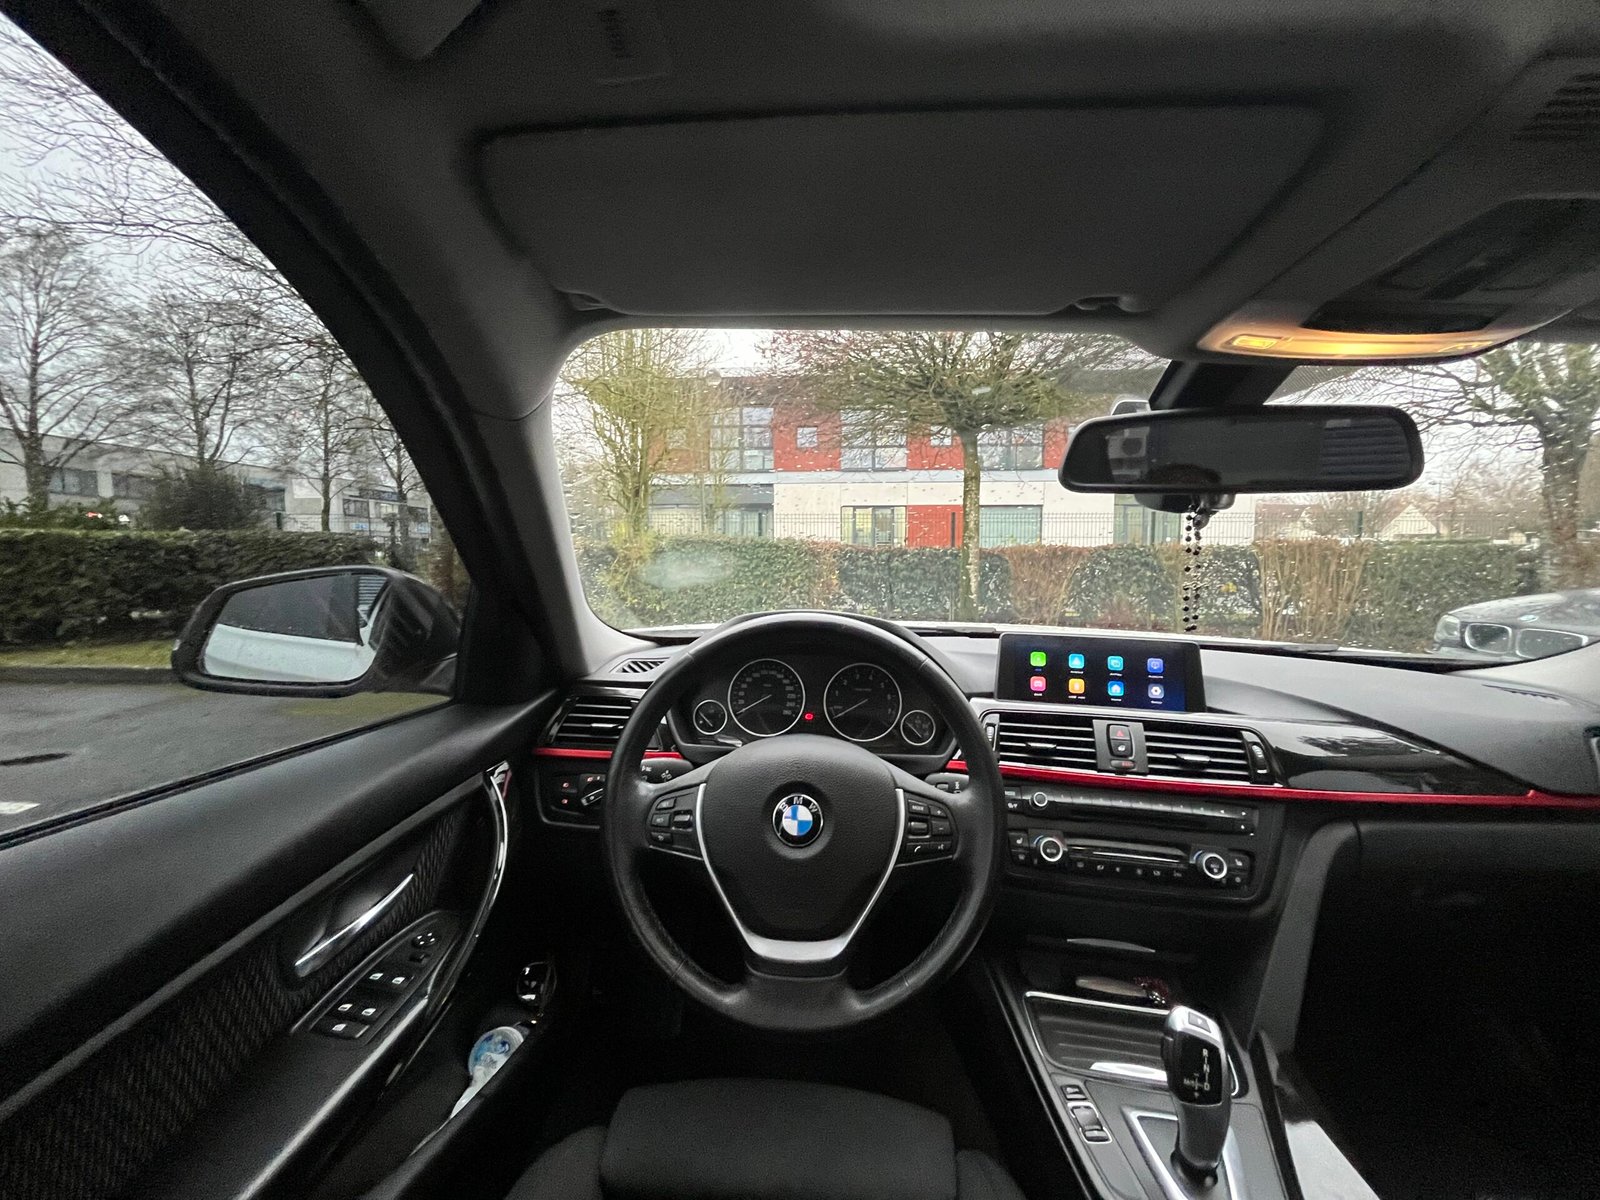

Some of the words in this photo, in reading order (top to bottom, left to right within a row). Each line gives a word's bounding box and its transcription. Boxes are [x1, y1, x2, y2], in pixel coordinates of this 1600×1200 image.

[779, 796, 818, 812] BMW
[1202, 1048, 1209, 1057] R
[1203, 1063, 1210, 1073] N
